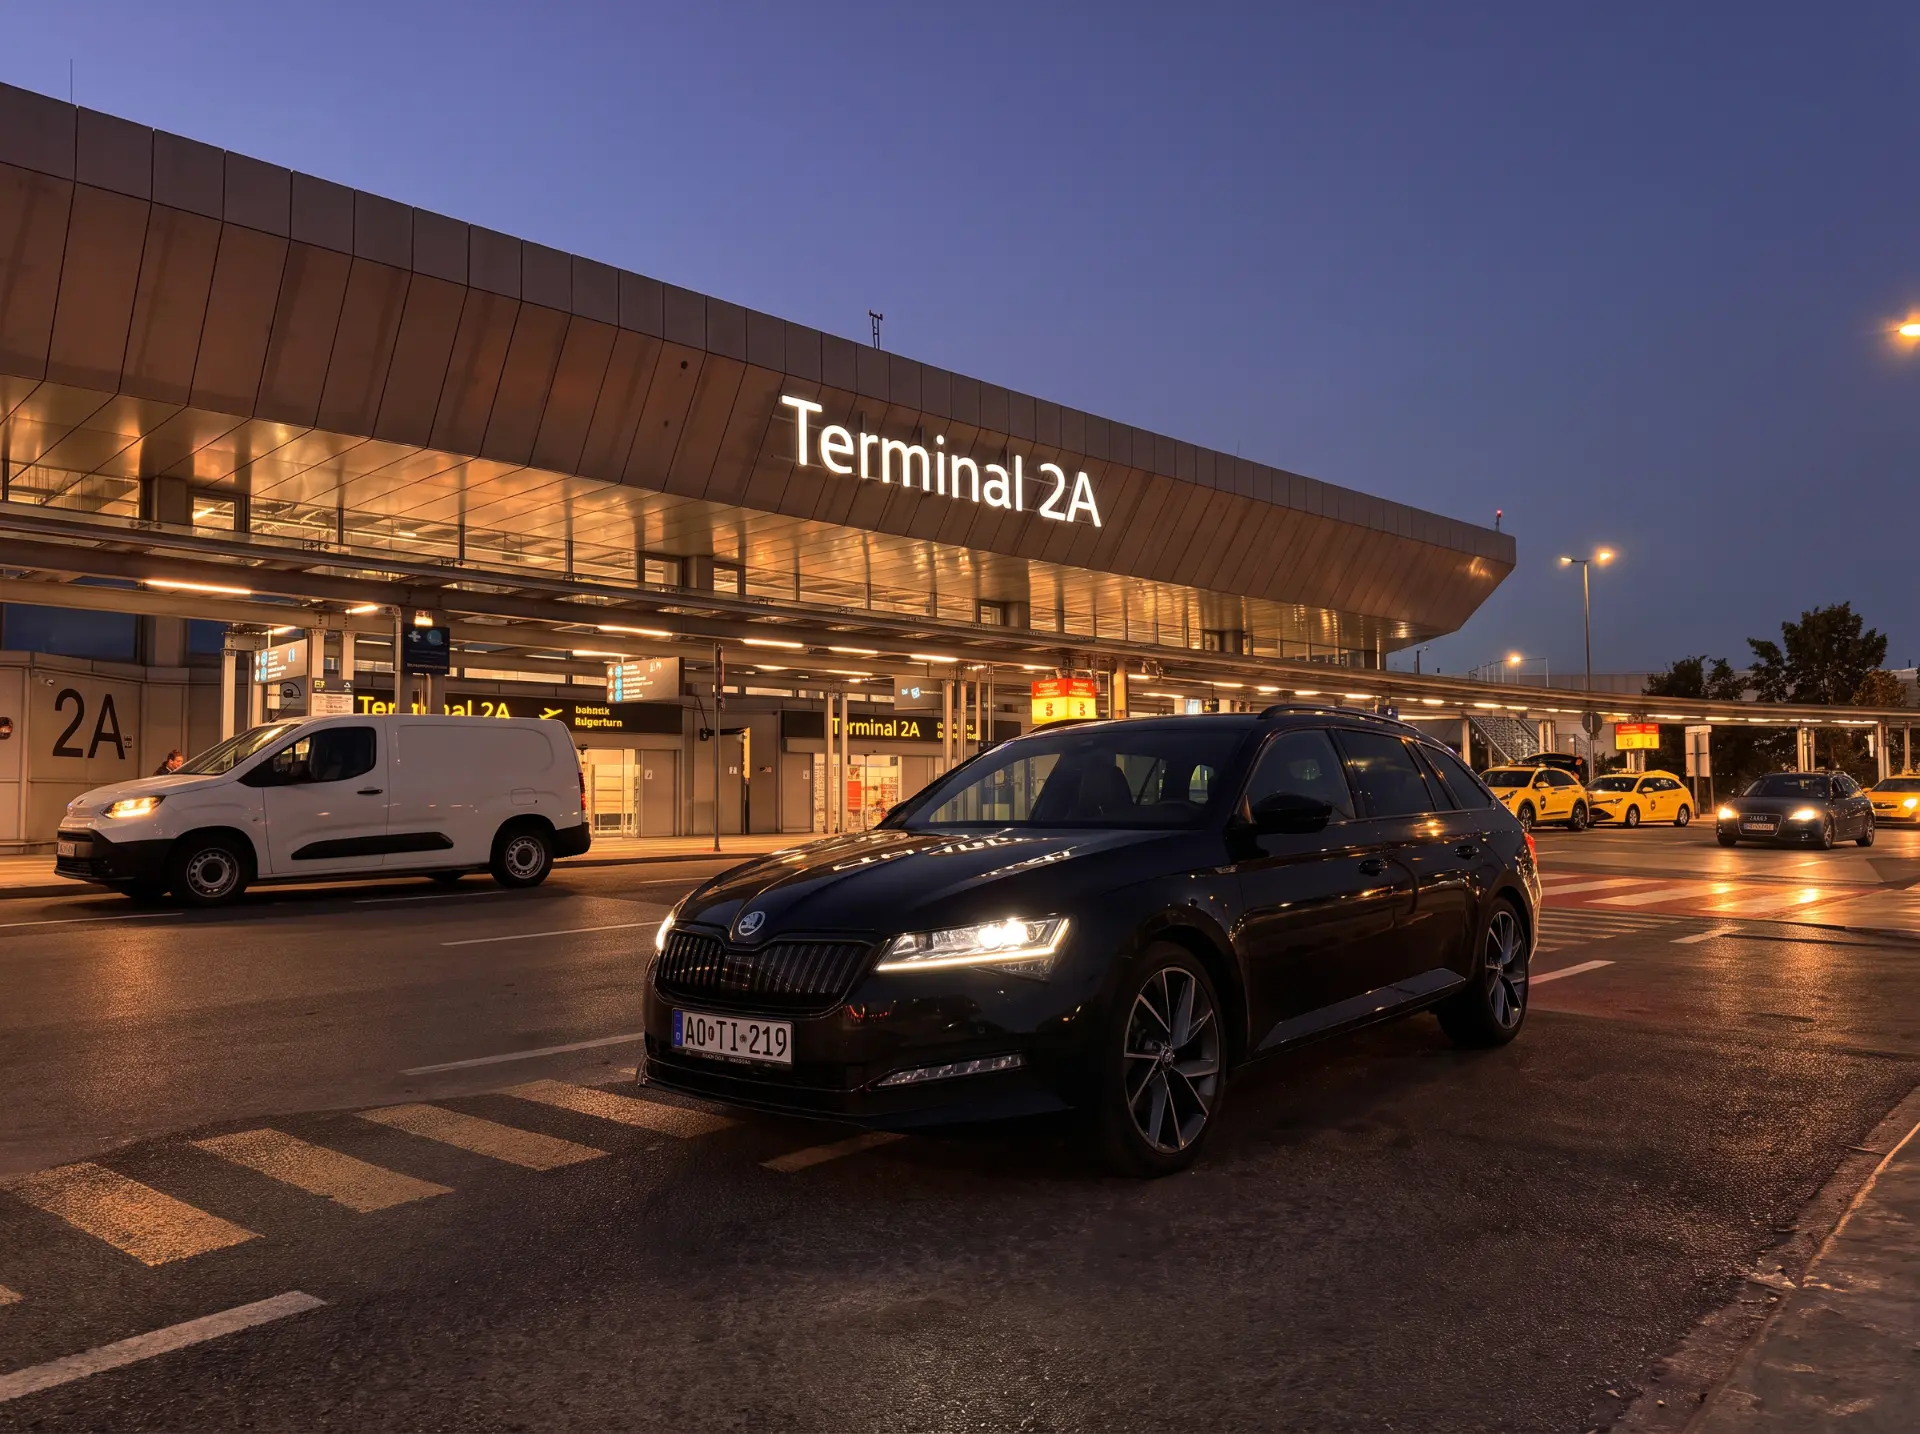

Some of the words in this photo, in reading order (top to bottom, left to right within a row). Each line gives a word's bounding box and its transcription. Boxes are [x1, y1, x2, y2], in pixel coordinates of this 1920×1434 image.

[781, 394, 1023, 512] Terminal
[1038, 462, 1102, 528] 2A
[53, 688, 125, 760] 2A
[481, 702, 510, 719] 2A
[832, 717, 897, 737] Trminal
[900, 720, 921, 738] 2A
[748, 1024, 788, 1057] 219
